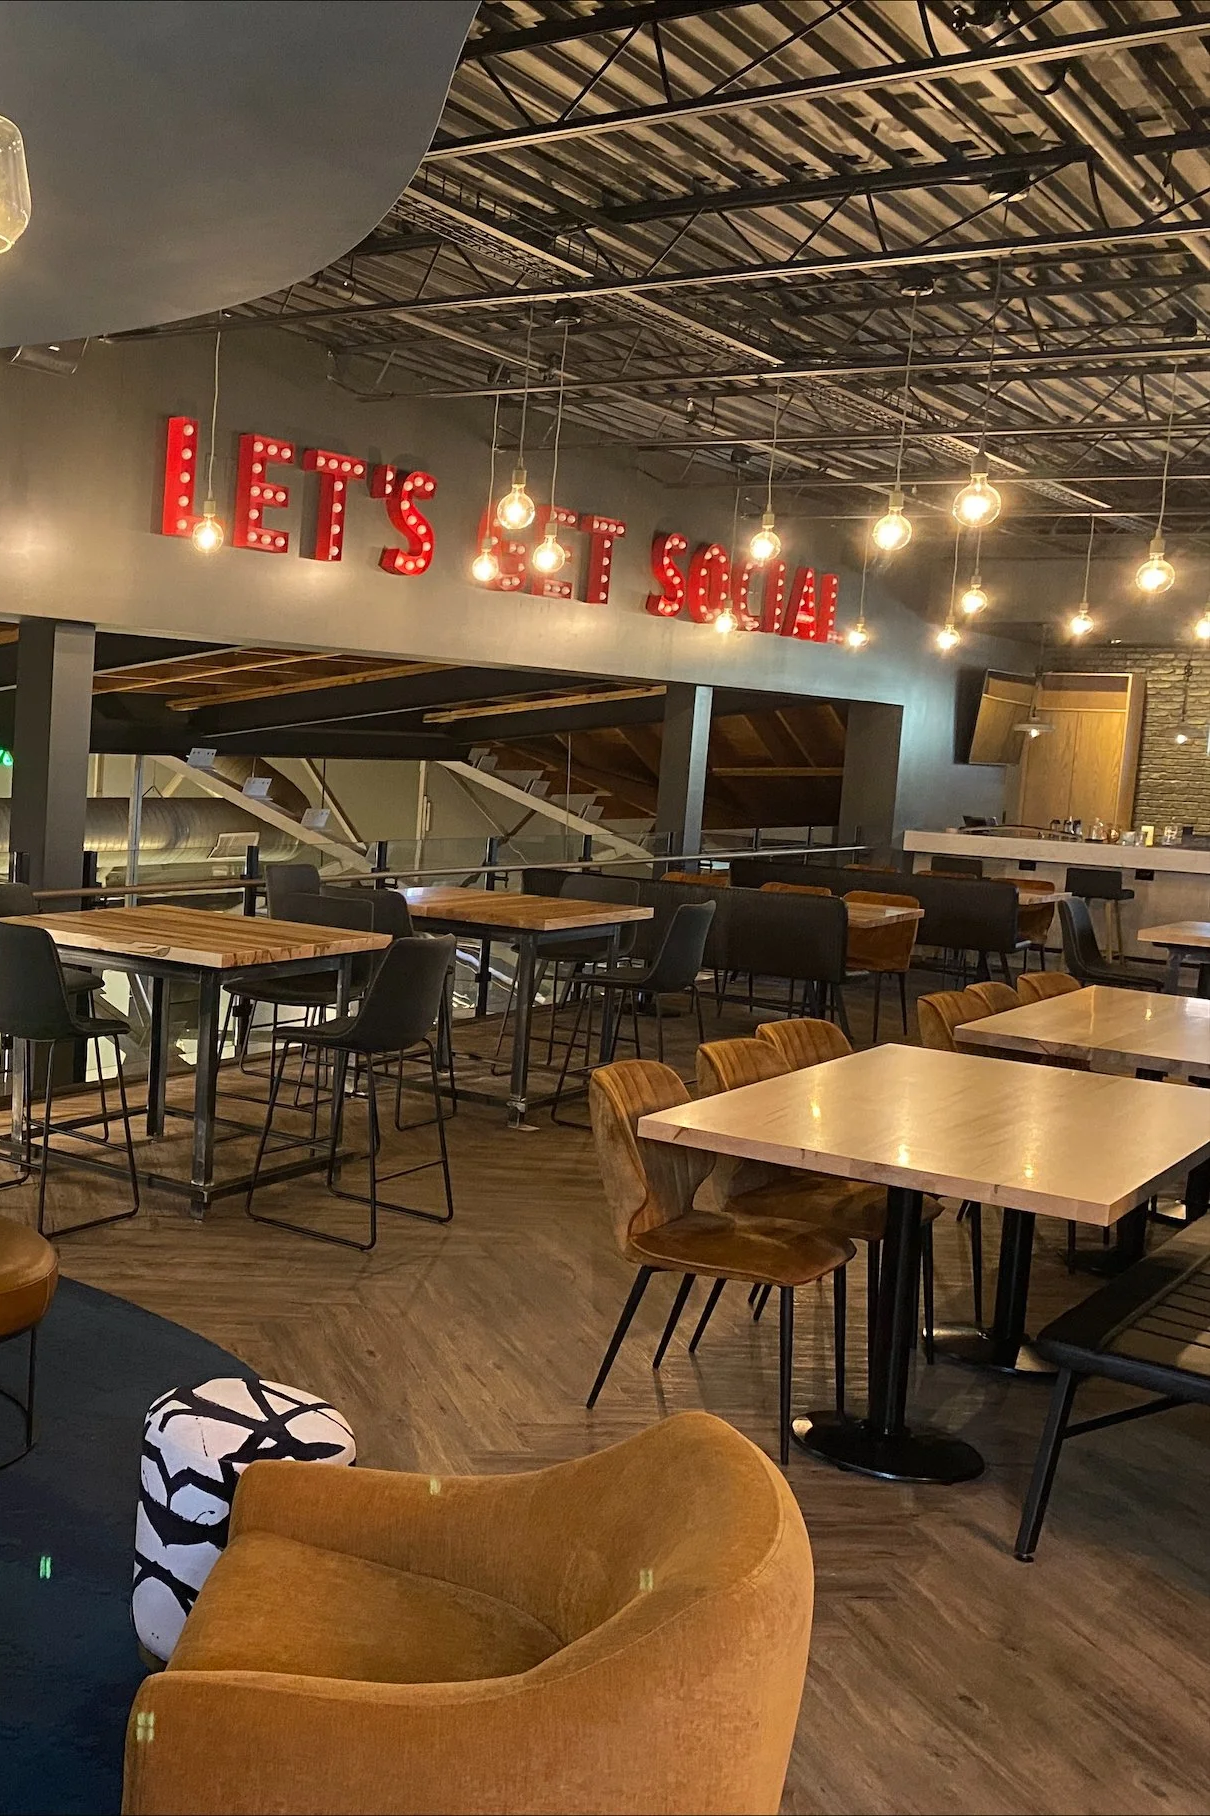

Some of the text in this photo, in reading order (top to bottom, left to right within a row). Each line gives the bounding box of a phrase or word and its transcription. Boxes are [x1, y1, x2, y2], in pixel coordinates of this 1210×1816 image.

[162, 416, 843, 644] LET'S GET SOCIAL
